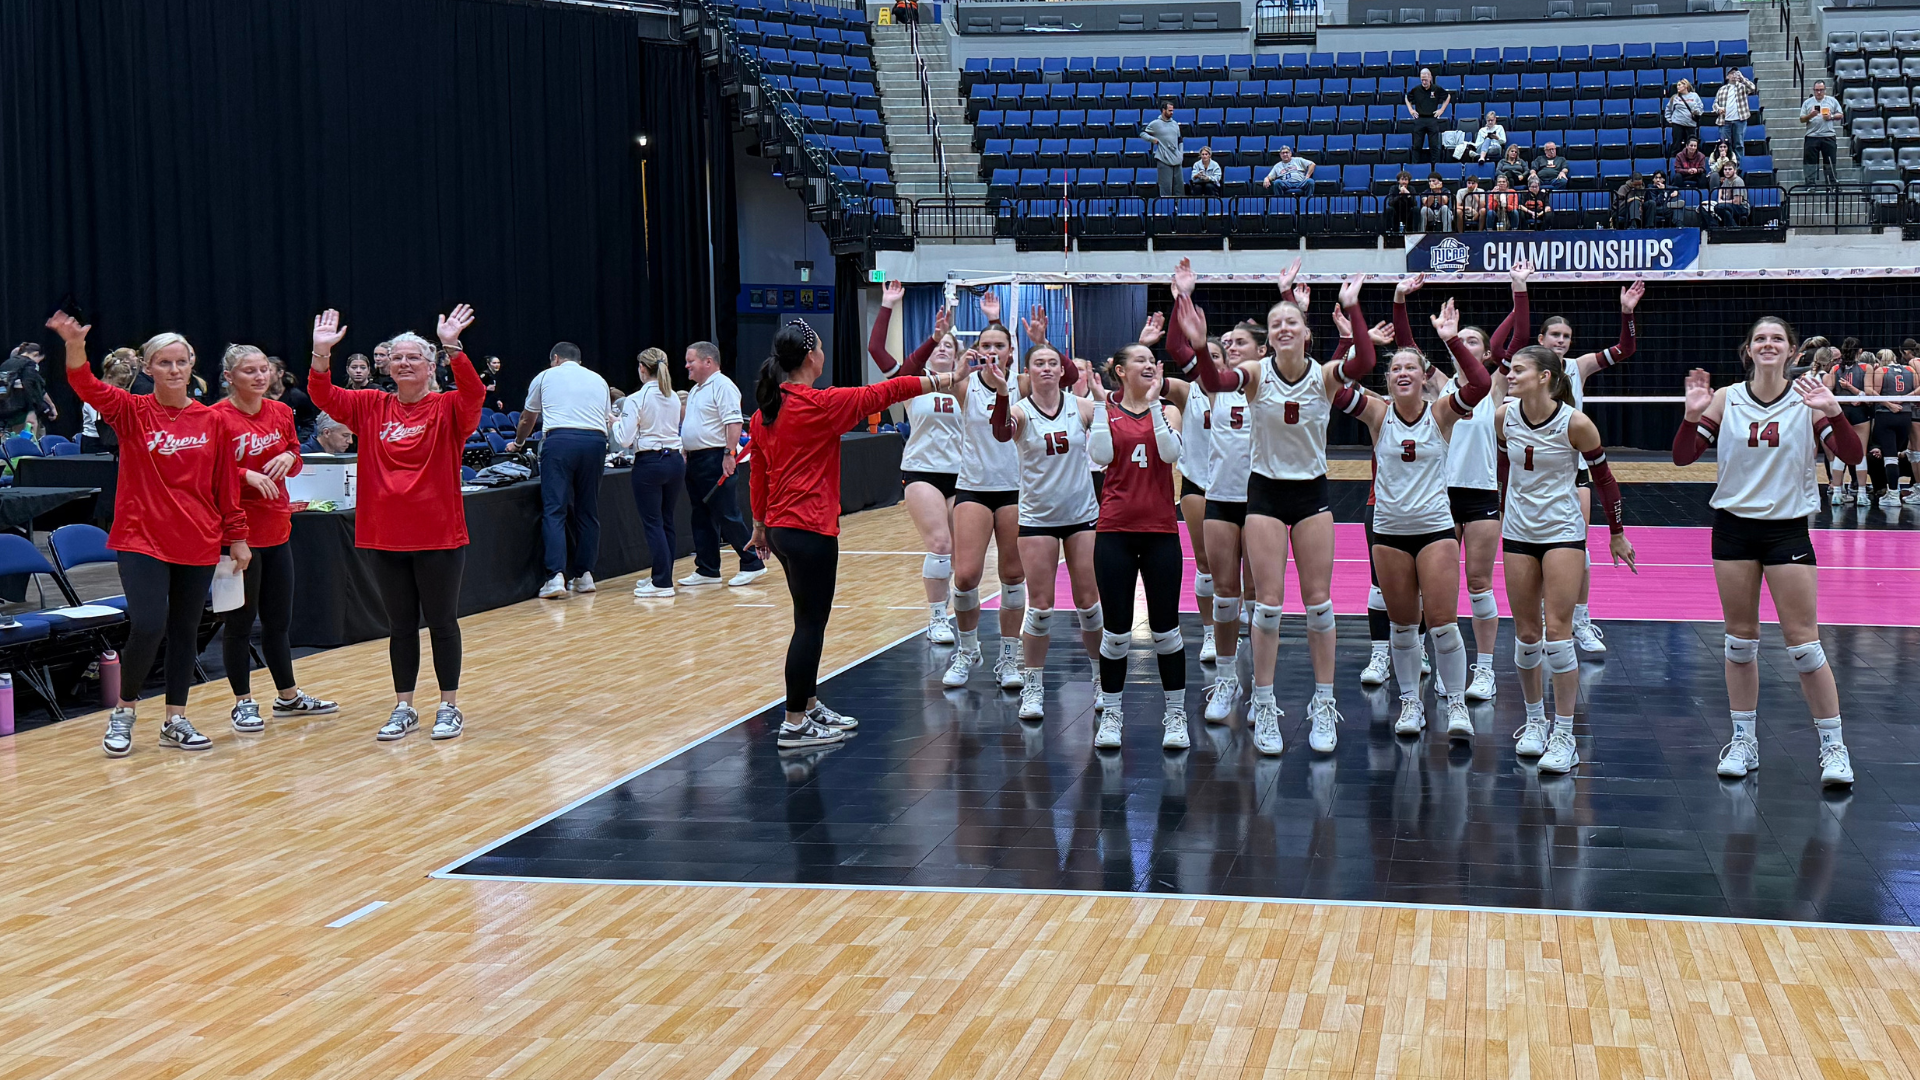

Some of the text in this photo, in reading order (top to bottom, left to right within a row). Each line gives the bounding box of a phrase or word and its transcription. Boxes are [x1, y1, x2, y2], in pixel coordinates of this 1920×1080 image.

[1432, 247, 1467, 265] NJCAA
[1483, 238, 1674, 270] CHAMPIONSHIPS
[1895, 375, 1905, 392] 6
[933, 396, 955, 413] 12
[1230, 406, 1244, 430] 5
[147, 430, 209, 455] Flyers
[232, 428, 283, 461] Flyers
[1044, 430, 1070, 456] 15
[1747, 421, 1780, 448] 14
[1131, 443, 1148, 468] 4
[1400, 439, 1417, 462] 3
[1523, 445, 1535, 471] 1
